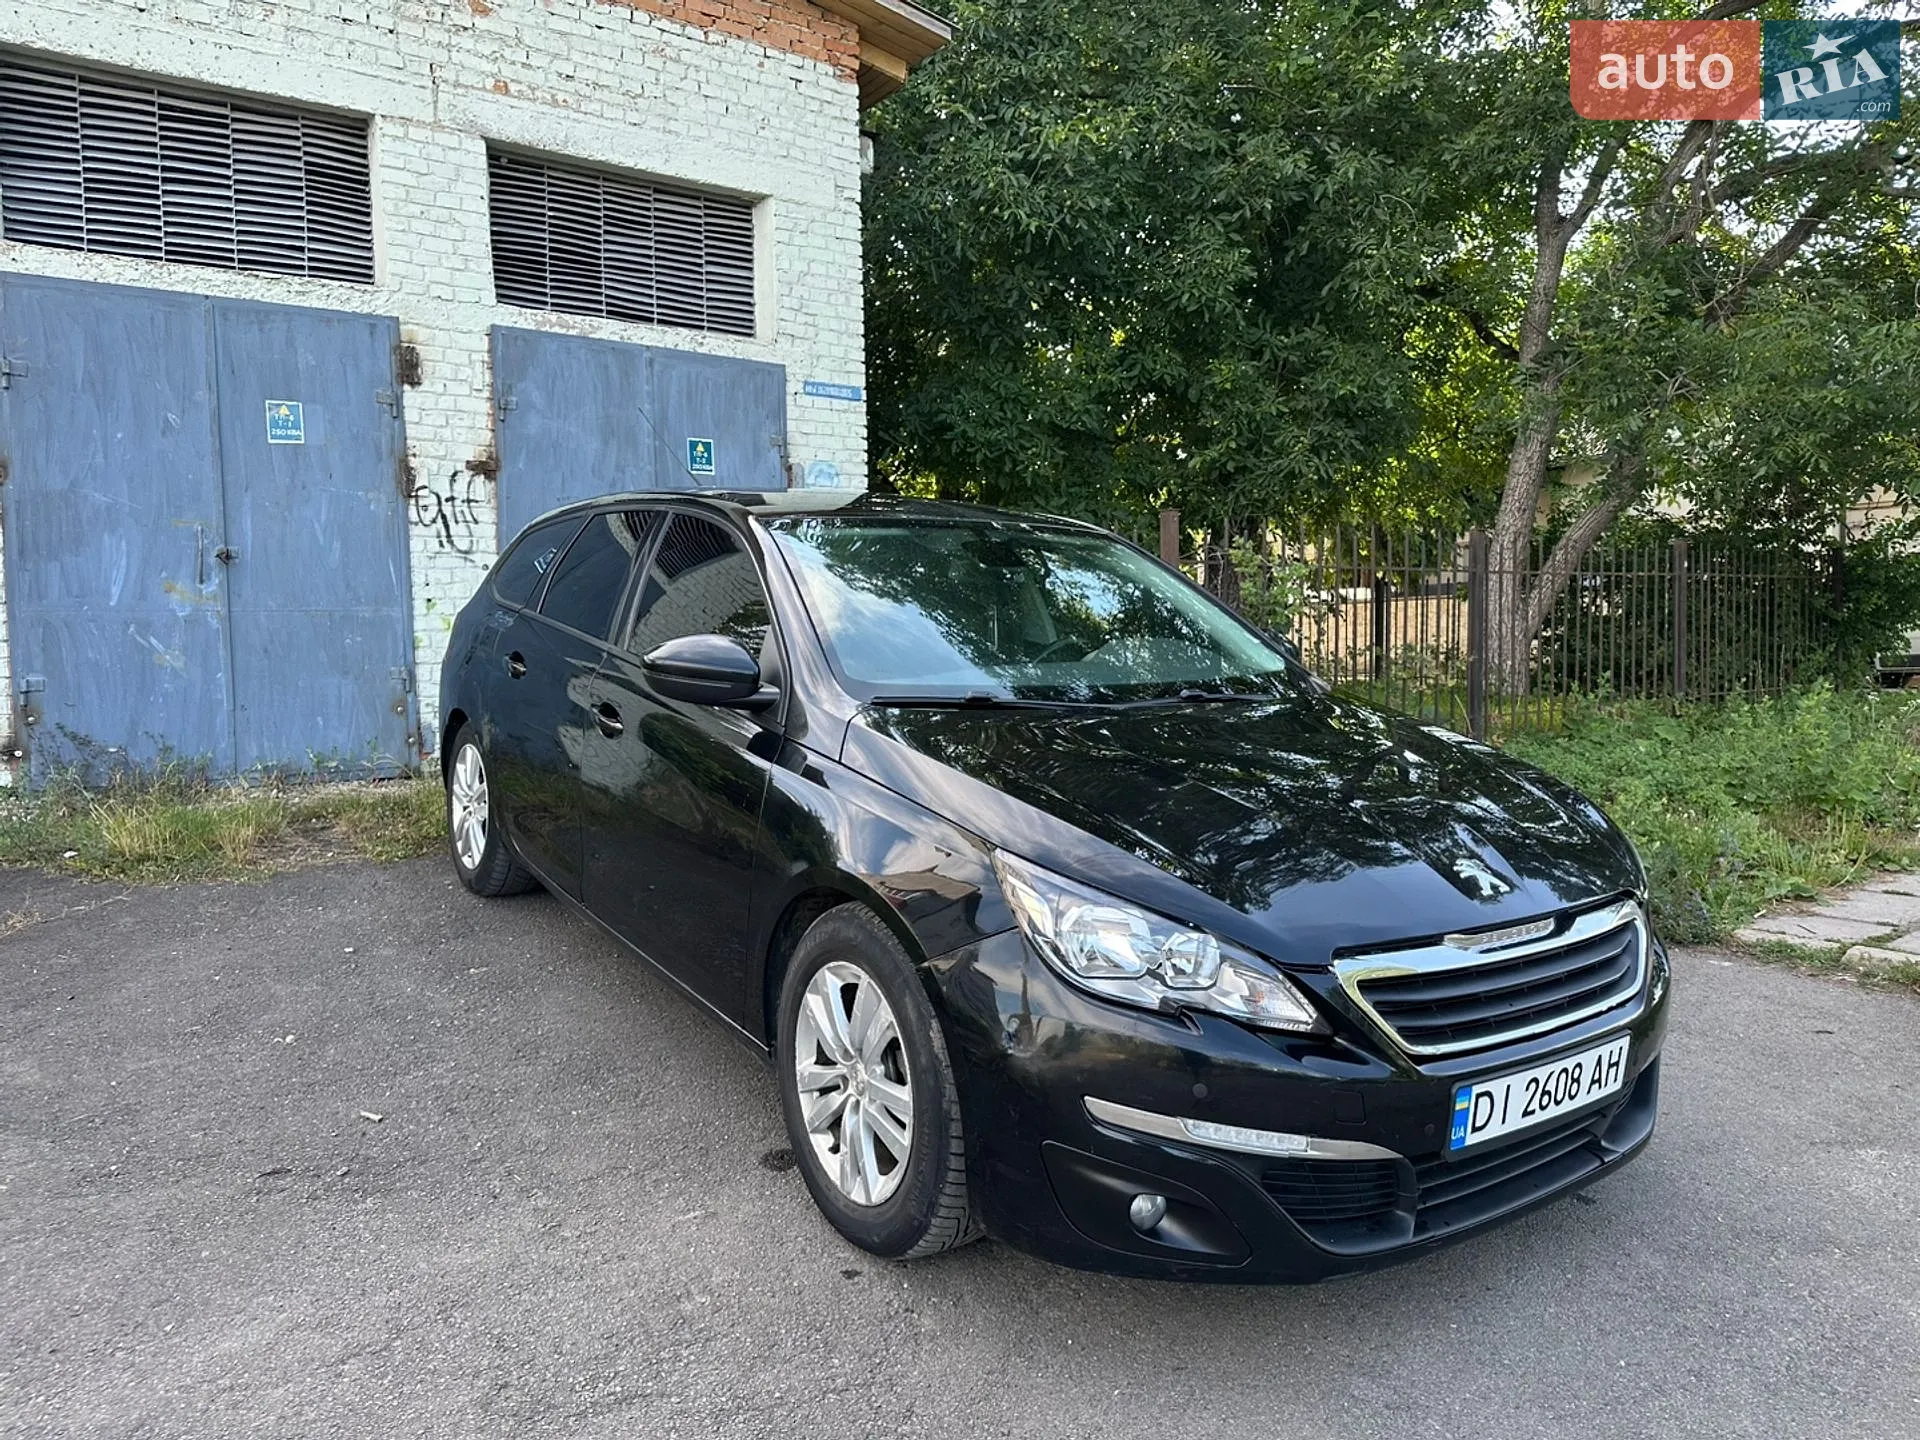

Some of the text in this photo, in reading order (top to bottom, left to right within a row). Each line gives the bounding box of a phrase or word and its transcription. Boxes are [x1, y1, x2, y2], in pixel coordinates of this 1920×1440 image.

[1470, 1046, 1623, 1135] DI 2608 AH
[1450, 1125, 1465, 1140] UA
